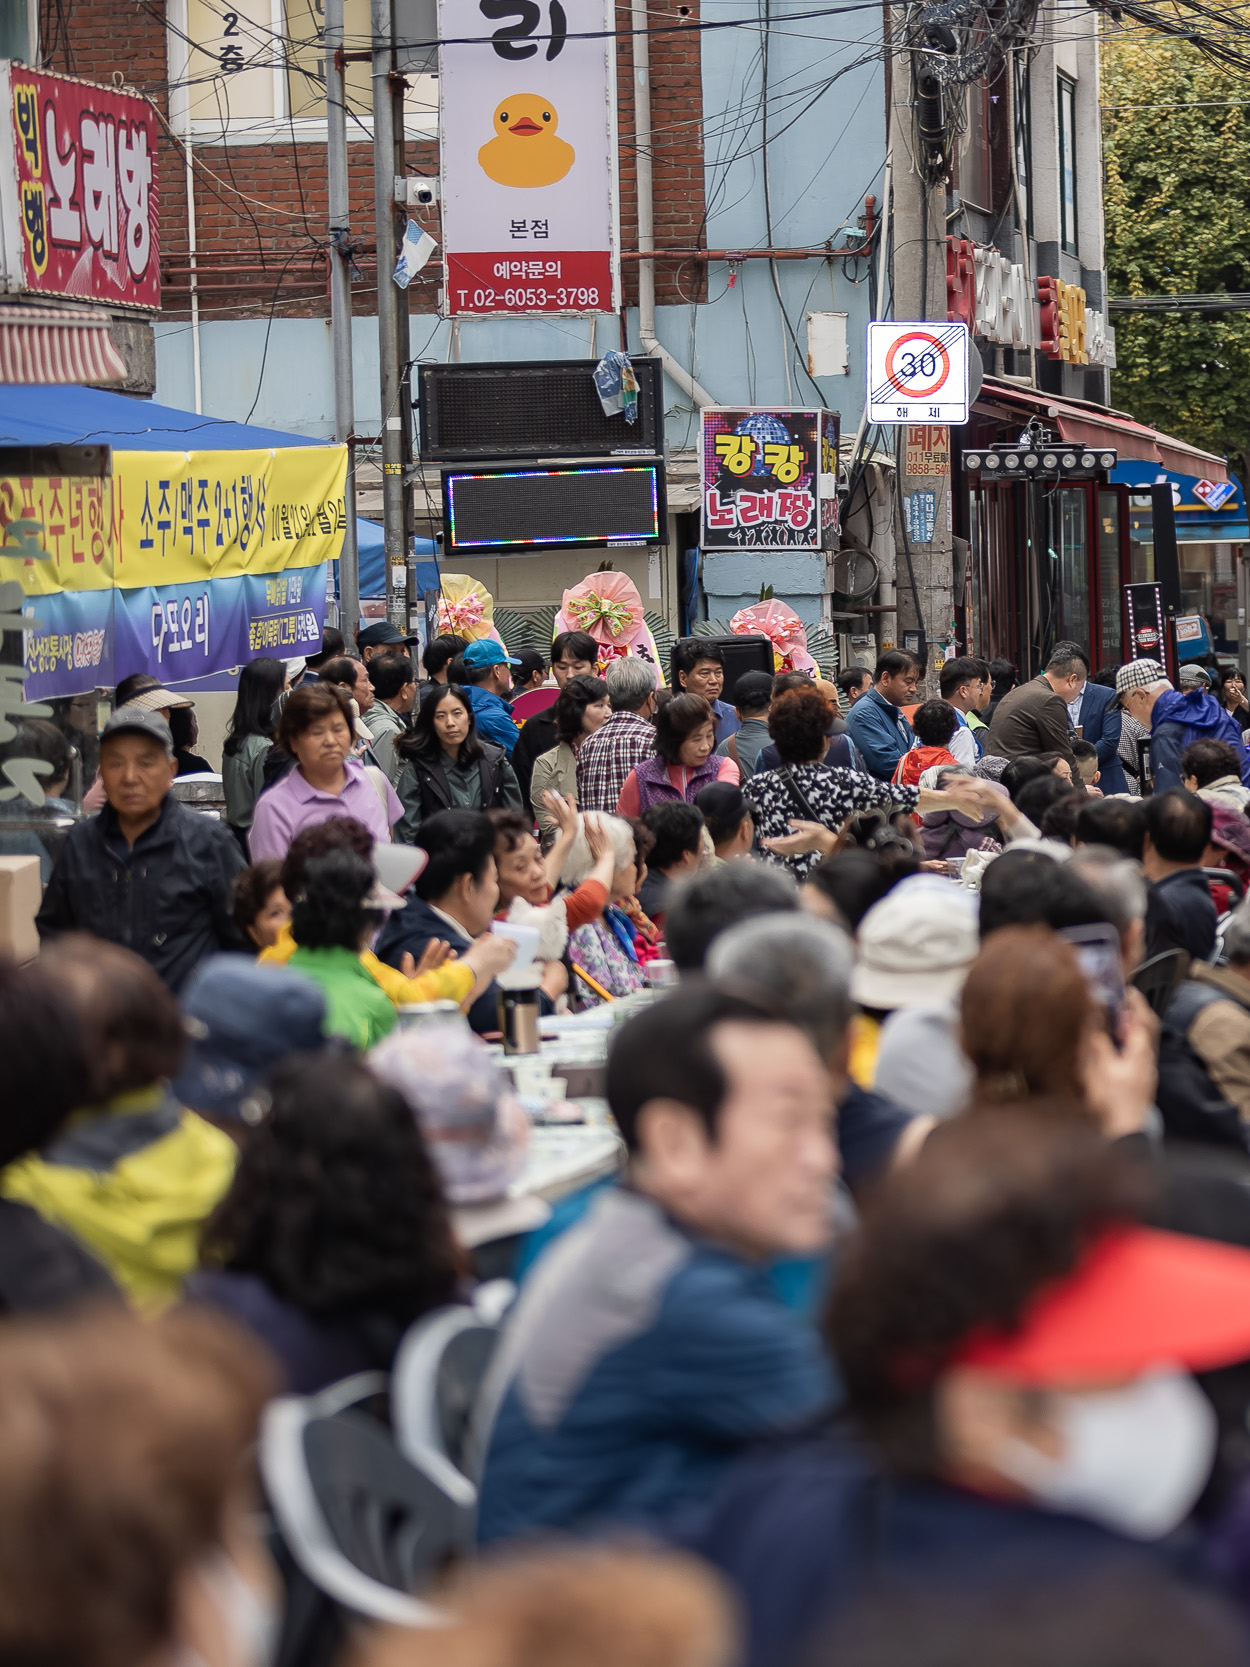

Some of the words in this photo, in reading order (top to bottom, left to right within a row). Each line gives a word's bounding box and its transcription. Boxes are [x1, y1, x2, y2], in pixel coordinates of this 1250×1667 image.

[15, 84, 48, 275] 빅뱅
[45, 102, 153, 282] 노래방
[509, 219, 549, 239] 본점
[493, 261, 561, 279] 예약문의
[457, 287, 599, 308] T.02-6053-3798
[901, 352, 936, 377] 30
[907, 452, 923, 463] 011
[907, 463, 950, 475] 9858-54
[708, 490, 813, 530] 노래짱
[152, 592, 210, 664] 다또오리
